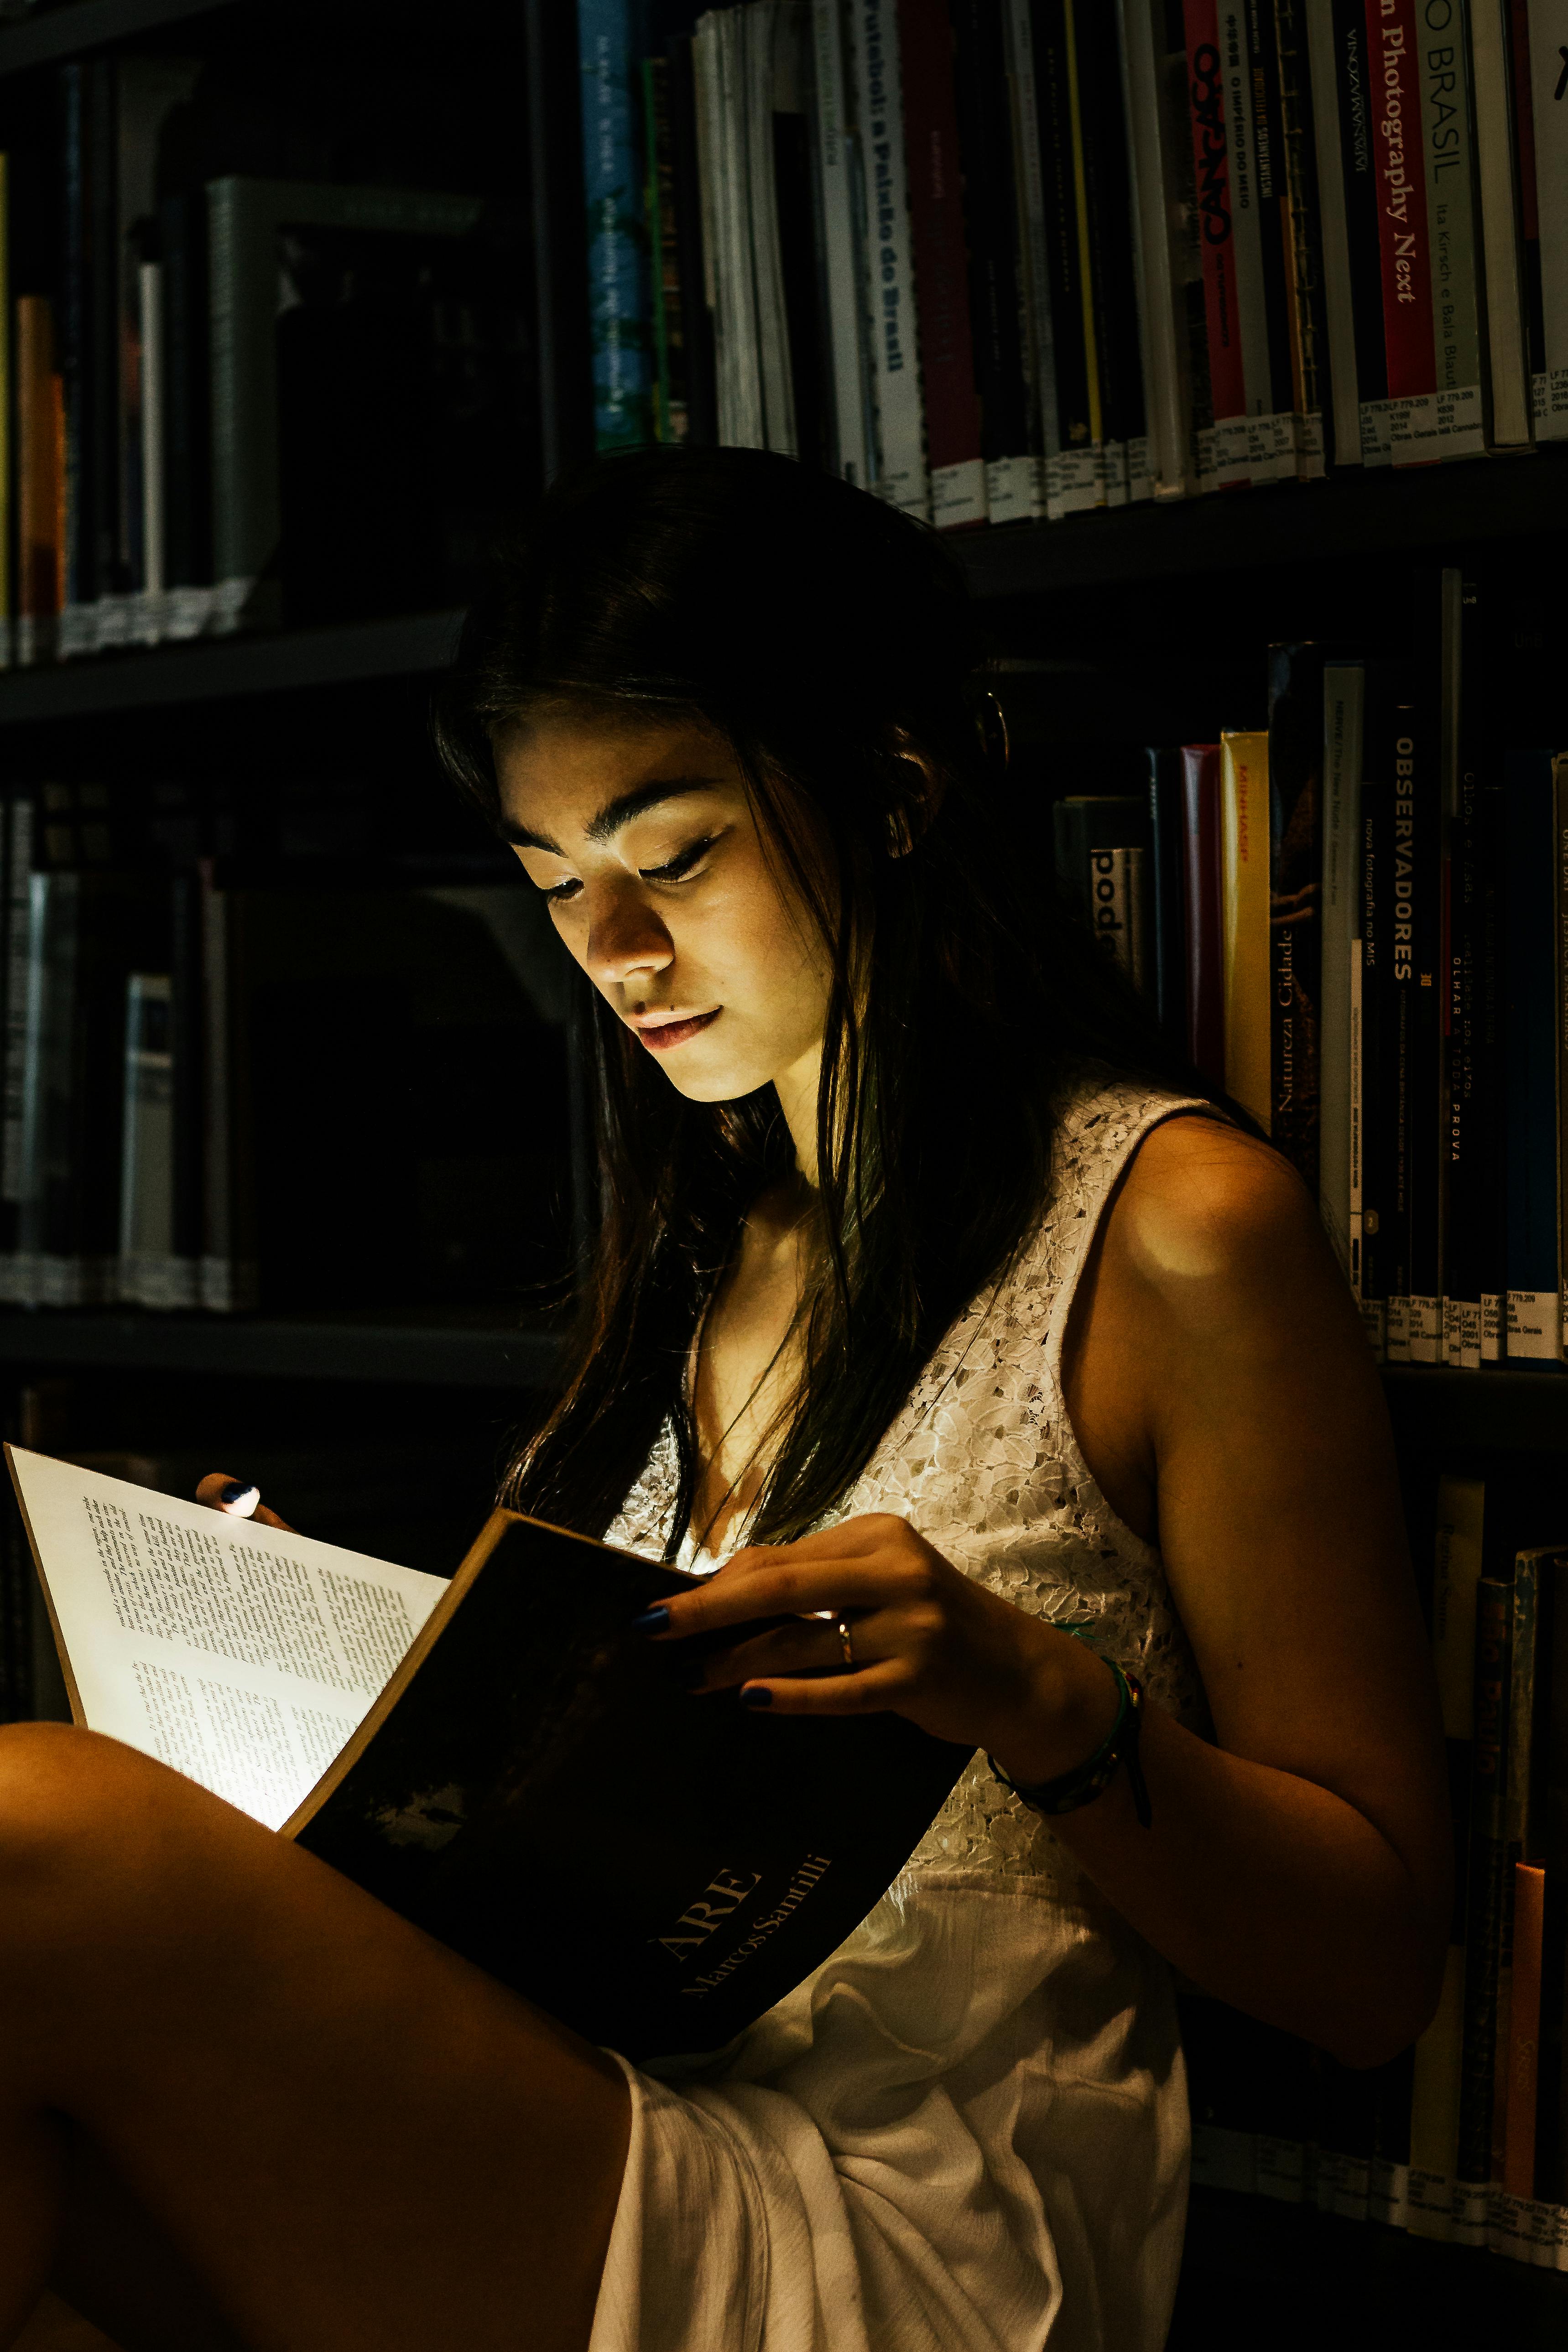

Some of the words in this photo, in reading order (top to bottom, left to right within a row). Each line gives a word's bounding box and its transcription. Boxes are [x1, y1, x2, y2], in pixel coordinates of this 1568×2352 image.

[1425, 0, 1452, 31] O
[1253, 67, 1267, 112] FELICIDADE
[1346, 27, 1368, 174] JAPANAMAZÔNIA
[1232, 89, 1246, 148] IMPÉRIO
[1380, 24, 1414, 223] Photography
[1427, 47, 1460, 184] BRASIL
[1192, 41, 1231, 245] CANGAÇO
[1236, 151, 1247, 171] DO
[1255, 126, 1274, 198] INSTANTÂNEOS
[1238, 174, 1250, 208] MEIO
[1436, 204, 1448, 225] Ita
[880, 245, 898, 282] do
[1437, 231, 1453, 282] Kirsch
[1393, 232, 1417, 304] Next
[1441, 288, 1451, 299] e
[882, 287, 904, 372] Brasil
[1441, 304, 1455, 339] Bala
[1438, 416, 1454, 425] 2012
[1463, 596, 1477, 604] UnB
[1365, 817, 1373, 849] nova
[1394, 737, 1414, 981] OBSERVADORES
[1364, 853, 1376, 920] fotografia
[1365, 921, 1374, 939] no
[1366, 941, 1377, 967] MIS
[1278, 929, 1293, 1007] Cidade
[1453, 957, 1461, 1015] OLHAR
[1453, 1027, 1461, 1036] A
[1278, 1018, 1293, 1113] Natureza
[1452, 1047, 1461, 1091] TODA
[1452, 1103, 1461, 1161] PROVA
[82, 1496, 91, 1511] tribe
[89, 1498, 101, 1514] other
[108, 1504, 118, 1515] old
[94, 1514, 105, 1529] each
[113, 1518, 122, 1529] the
[138, 1513, 146, 1527] time
[99, 1530, 109, 1543] help
[125, 1532, 135, 1541] of
[142, 1529, 152, 1545] same
[97, 1548, 105, 1558] the
[105, 1544, 114, 1556] they
[109, 1529, 123, 1563] movements
[119, 1541, 133, 1568] occurred
[130, 1543, 138, 1557] way
[147, 1547, 156, 1557] the
[106, 1556, 117, 1570] and
[118, 1563, 127, 1576] The
[135, 1559, 141, 1567] no
[151, 1558, 158, 1566] at
[103, 1569, 117, 1597] crescendo
[128, 1571, 141, 1591] which
[138, 1569, 146, 1582] was
[153, 1567, 162, 1581] that
[142, 1584, 151, 1600] there
[120, 1596, 130, 1613] about
[128, 1598, 138, 1607] of
[136, 1594, 146, 1610] those
[148, 1602, 157, 1619] when
[155, 1597, 167, 1615] fierce
[161, 1591, 175, 1620] difference
[113, 1603, 126, 1628] reached
[126, 1614, 135, 1630] hears
[133, 1608, 142, 1624] times
[160, 1616, 168, 1626] the
[146, 1624, 154, 1635] ilar
[165, 1628, 173, 1641] ling
[171, 1622, 179, 1634] The
[1481, 1602, 1506, 1664] São
[1477, 1680, 1503, 1774] Paulo
[680, 1934, 767, 1999] Marcos
